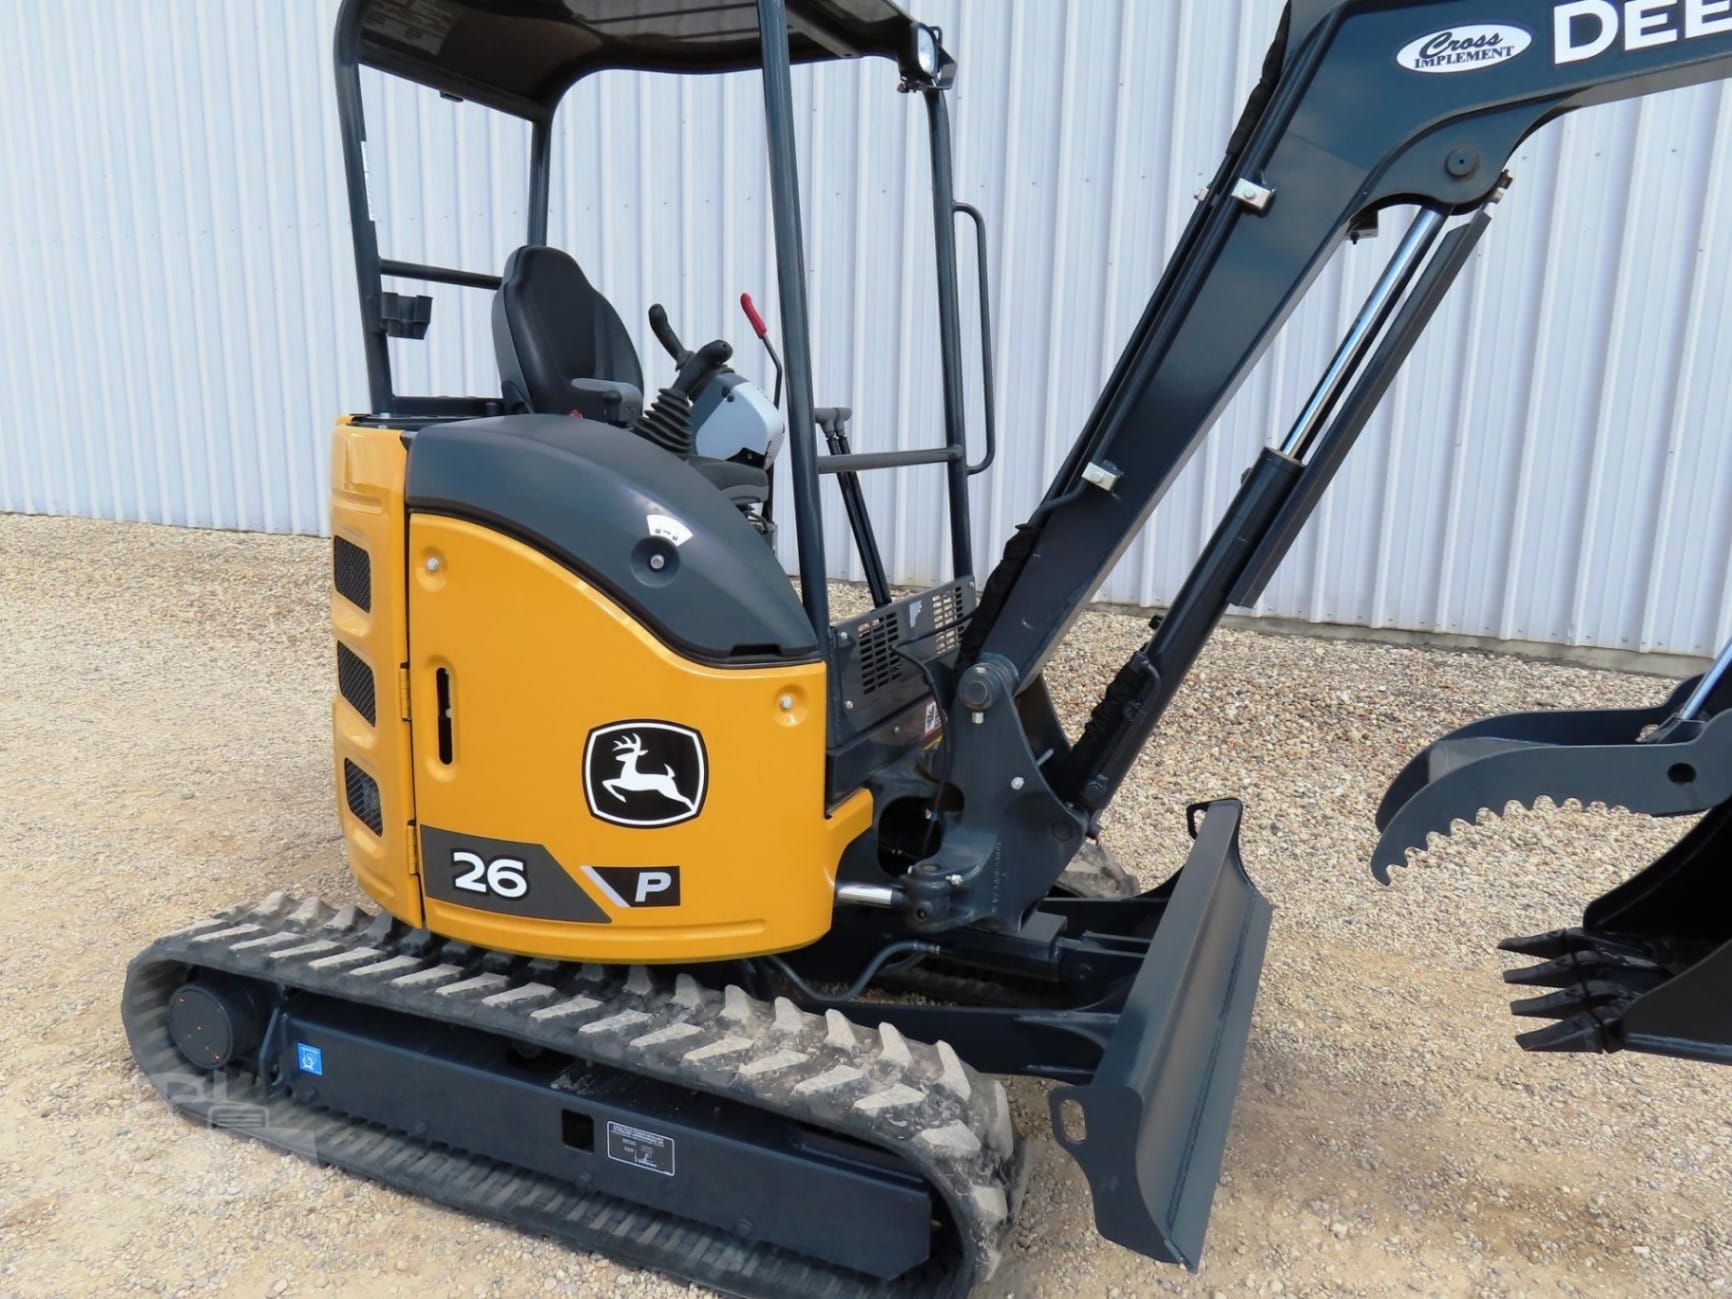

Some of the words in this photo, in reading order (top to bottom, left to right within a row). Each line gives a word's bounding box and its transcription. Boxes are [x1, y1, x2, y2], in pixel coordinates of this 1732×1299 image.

[1414, 45, 1515, 69] IMPLEMENT
[1418, 31, 1503, 58] Cross
[453, 851, 528, 898] 26
[634, 872, 673, 903] P
